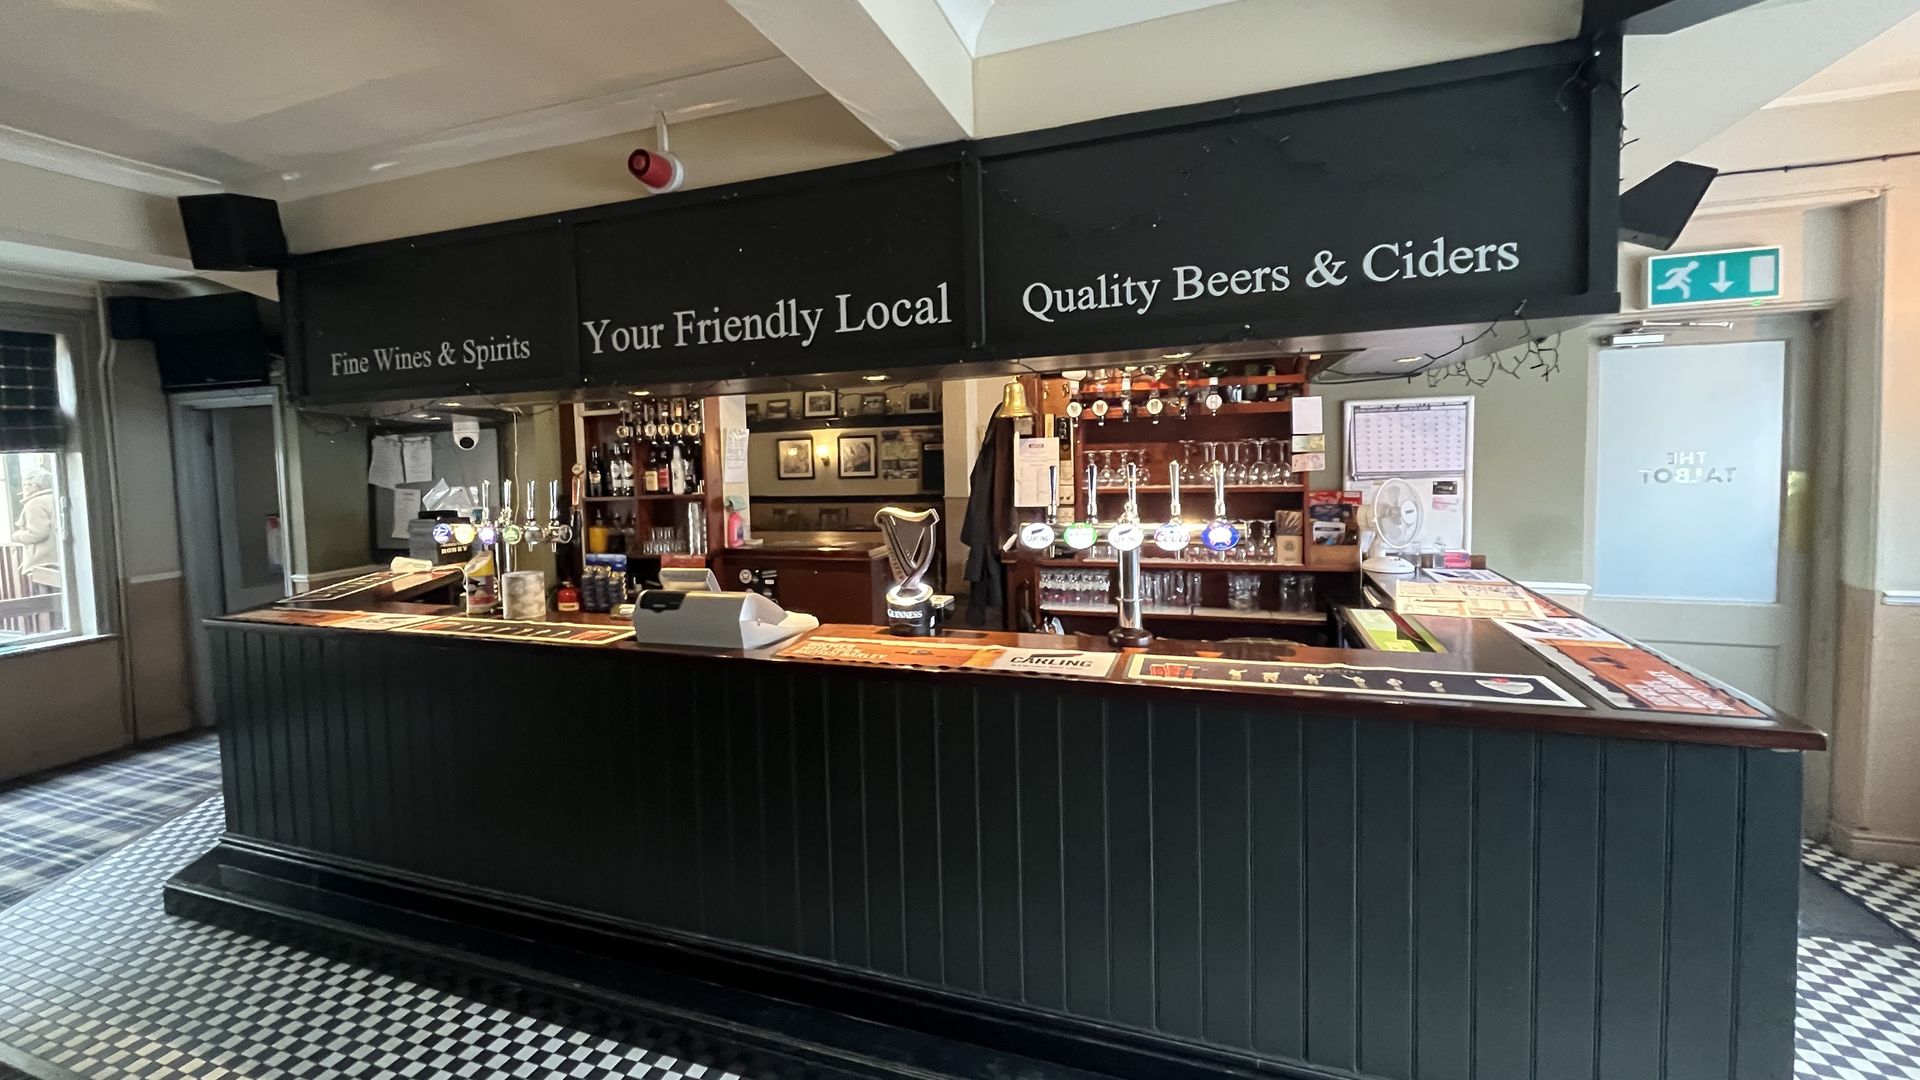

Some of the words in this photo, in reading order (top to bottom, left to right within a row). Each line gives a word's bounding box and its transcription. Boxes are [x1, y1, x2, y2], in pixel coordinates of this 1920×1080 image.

[1022, 273, 1162, 322] Quality
[1172, 262, 1290, 302] Beers
[1305, 250, 1348, 289] &
[1361, 236, 1520, 283] Ciders
[582, 318, 665, 354] Your
[673, 299, 824, 347] Friendly
[834, 282, 953, 334] Local
[331, 352, 369, 376] Fine
[373, 347, 432, 371] Wines
[437, 341, 457, 367] &
[462, 334, 531, 370] Spirits
[887, 608, 923, 619] GUINNESS
[1010, 654, 1094, 667] CARLING
